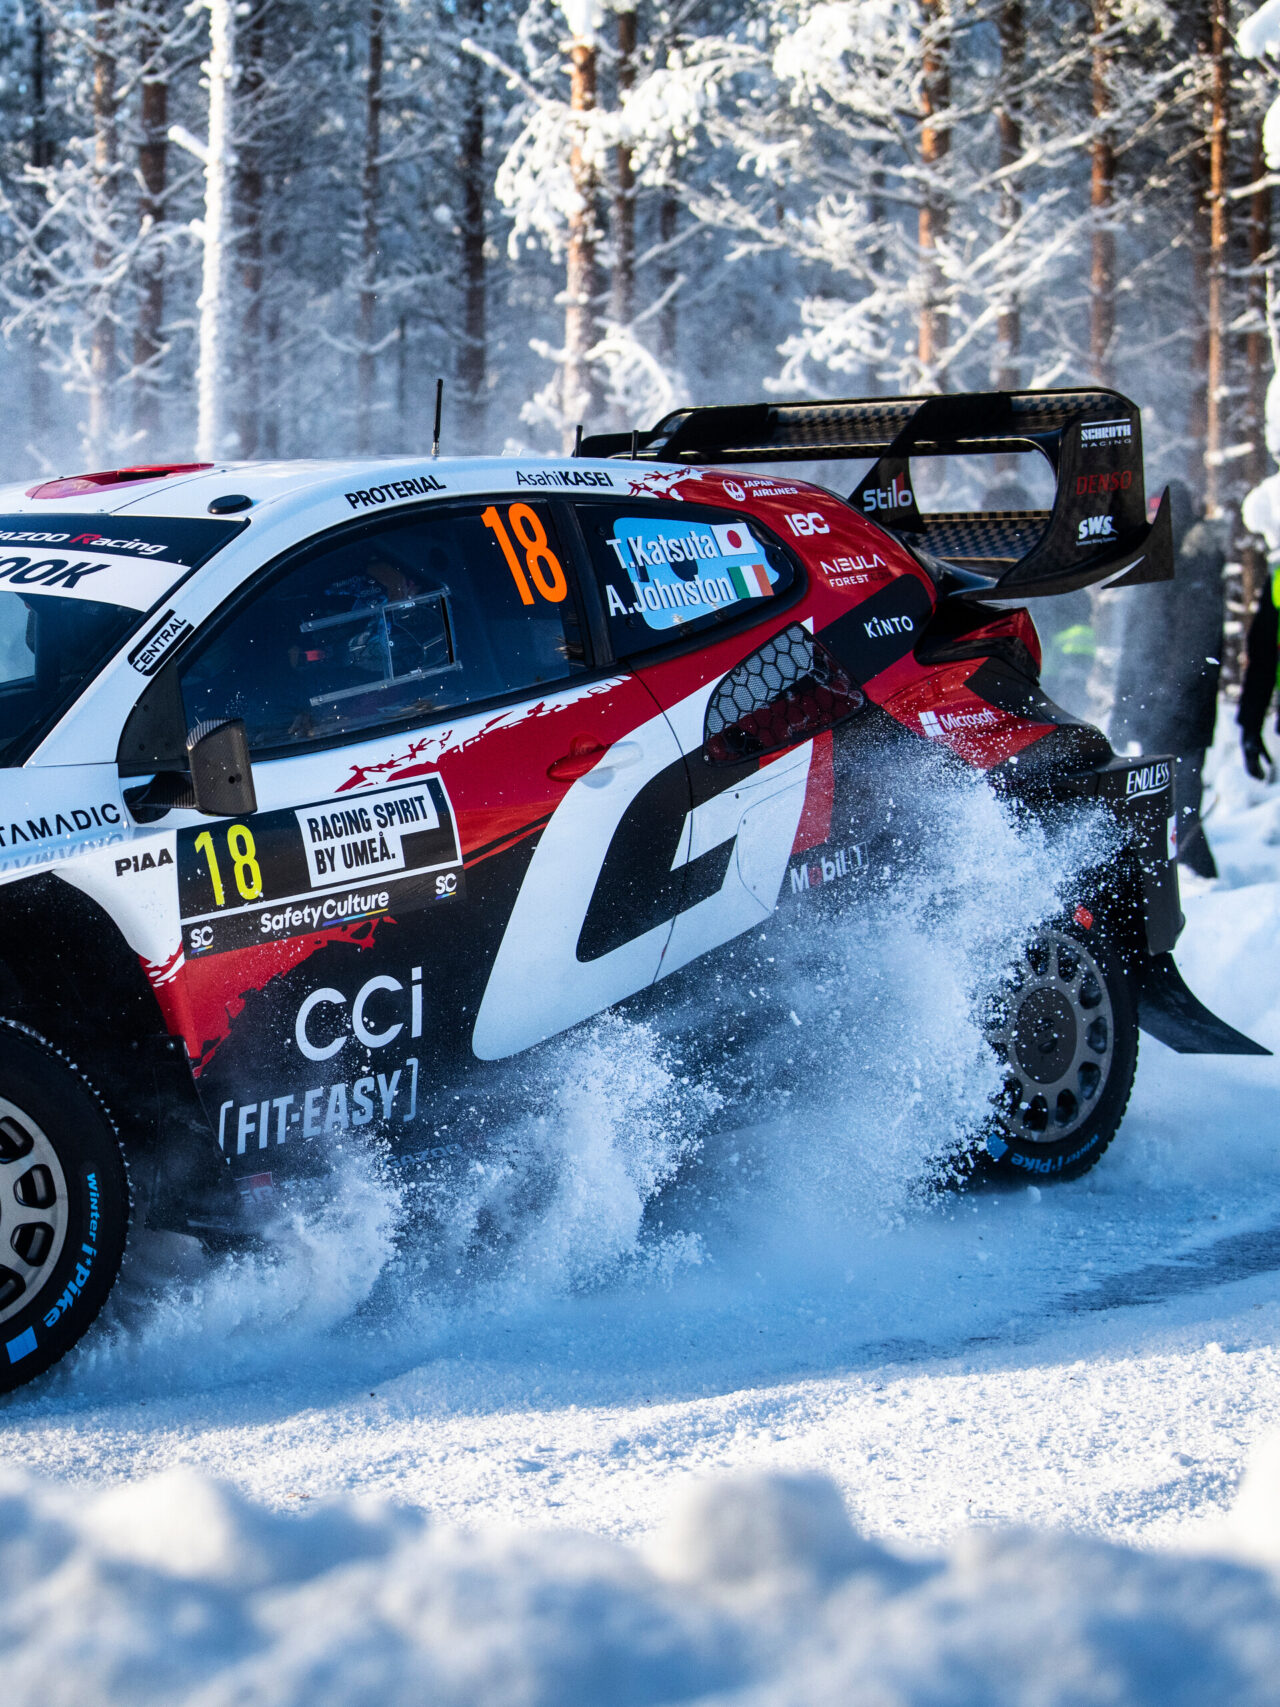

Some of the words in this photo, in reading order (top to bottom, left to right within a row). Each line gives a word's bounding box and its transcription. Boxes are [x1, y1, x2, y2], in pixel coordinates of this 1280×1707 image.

[344, 475, 447, 509] PROTERIAL
[516, 470, 614, 487] AsahiKASEI
[743, 480, 775, 488] JAPAN
[753, 487, 799, 497] AIRLINES
[863, 474, 913, 512] Stilo
[1076, 470, 1132, 495] DENSO
[70, 533, 168, 555] Racing
[1078, 515, 1115, 540] SWS
[481, 502, 568, 606] 18
[605, 530, 719, 570] T.Katsuta
[605, 574, 735, 617] A.Johnston
[133, 618, 187, 673] CENTRAL
[940, 707, 999, 730] Microsoft
[1126, 762, 1170, 795] ENDLESS
[307, 808, 372, 843] RACING
[376, 795, 428, 828] SPIRIT
[194, 824, 263, 906] 18
[314, 846, 337, 876] BY
[342, 831, 396, 869] UMEÅ.
[435, 873, 458, 895] SC
[789, 849, 848, 894] Mobil
[260, 891, 390, 934] SafetyCulture
[190, 926, 214, 949] SC
